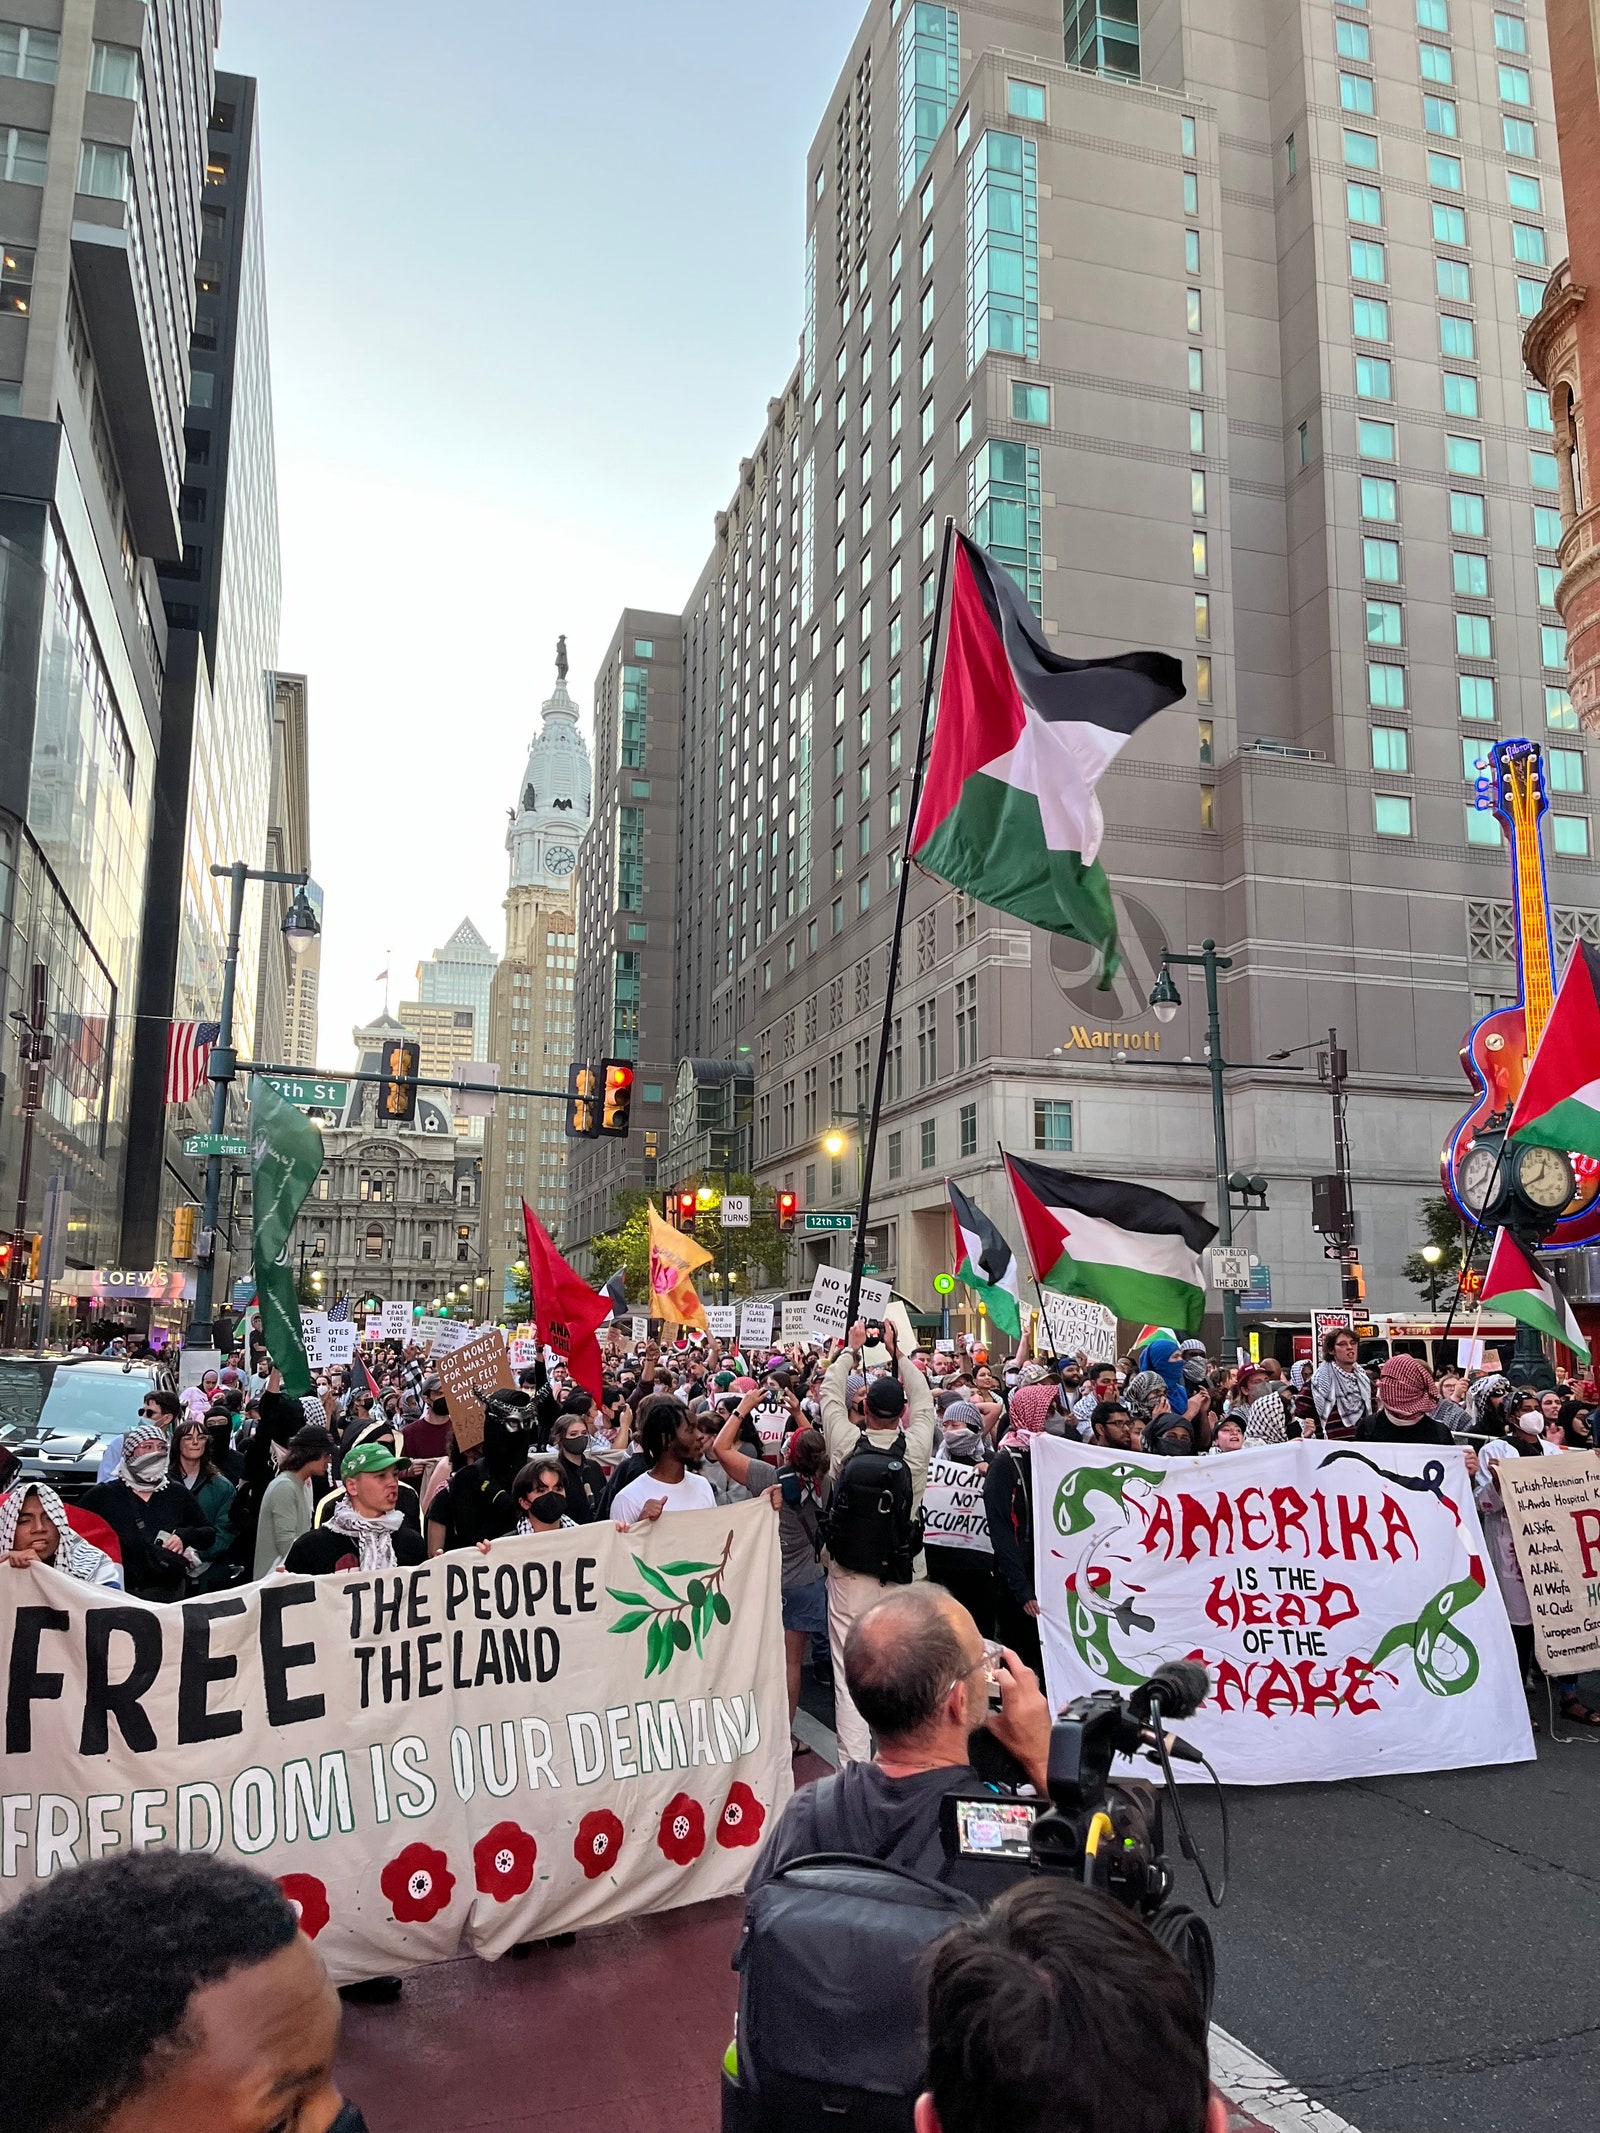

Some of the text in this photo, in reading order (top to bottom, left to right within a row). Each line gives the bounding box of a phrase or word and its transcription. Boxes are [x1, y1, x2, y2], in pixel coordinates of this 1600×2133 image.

[1063, 1025, 1160, 1051] Marriott
[314, 1085, 336, 1100] St
[220, 1146, 246, 1154] STREET
[728, 1200, 743, 1210] NO
[723, 1214, 749, 1222] TURNS
[811, 1217, 846, 1226] 12th St
[1230, 1249, 1248, 1257] BLOCK
[99, 1271, 168, 1286] LOEWS
[1216, 1279, 1248, 1288] THE BOX
[822, 1278, 882, 1303] NO VTES
[836, 1296, 850, 1308] FO
[1050, 1296, 1102, 1325] FREE
[550, 1320, 570, 1338] ANA
[813, 1314, 844, 1328] TAKE THE
[303, 1326, 321, 1334] ASE
[328, 1328, 349, 1336] OTES
[1038, 1314, 1116, 1357] PALESTINE
[304, 1336, 316, 1344] RE
[306, 1344, 314, 1352] O
[552, 1336, 570, 1352] PHIL
[308, 1352, 322, 1362] TE
[440, 1354, 458, 1372] GOT
[462, 1336, 496, 1361] MONEY
[444, 1348, 502, 1384] FOR WARS BUT
[478, 1364, 498, 1382] FEED
[456, 1389, 474, 1403] THE
[927, 1462, 985, 1488] EDUCAT
[1512, 1470, 1600, 1494] Turkish-Palestinian Frie
[950, 1492, 984, 1508] NOT
[1518, 1488, 1600, 1512] Al-Awda Hospital K
[919, 1506, 990, 1536] OCCUPATIO
[1138, 1486, 1419, 1564] AMERIKA
[1236, 1566, 1317, 1592] IS THE
[1533, 1580, 1570, 1596] Al Wafa
[343, 1557, 598, 1639] THE PEOPLE
[1205, 1576, 1360, 1632] HEAD
[1542, 1624, 1582, 1639] European
[1242, 1629, 1329, 1656] OF THE
[5, 1580, 326, 1756] FREE
[354, 1626, 560, 1709] THE LAND
[1, 1689, 762, 1878] FREEDOM IS OUR DEMAND
